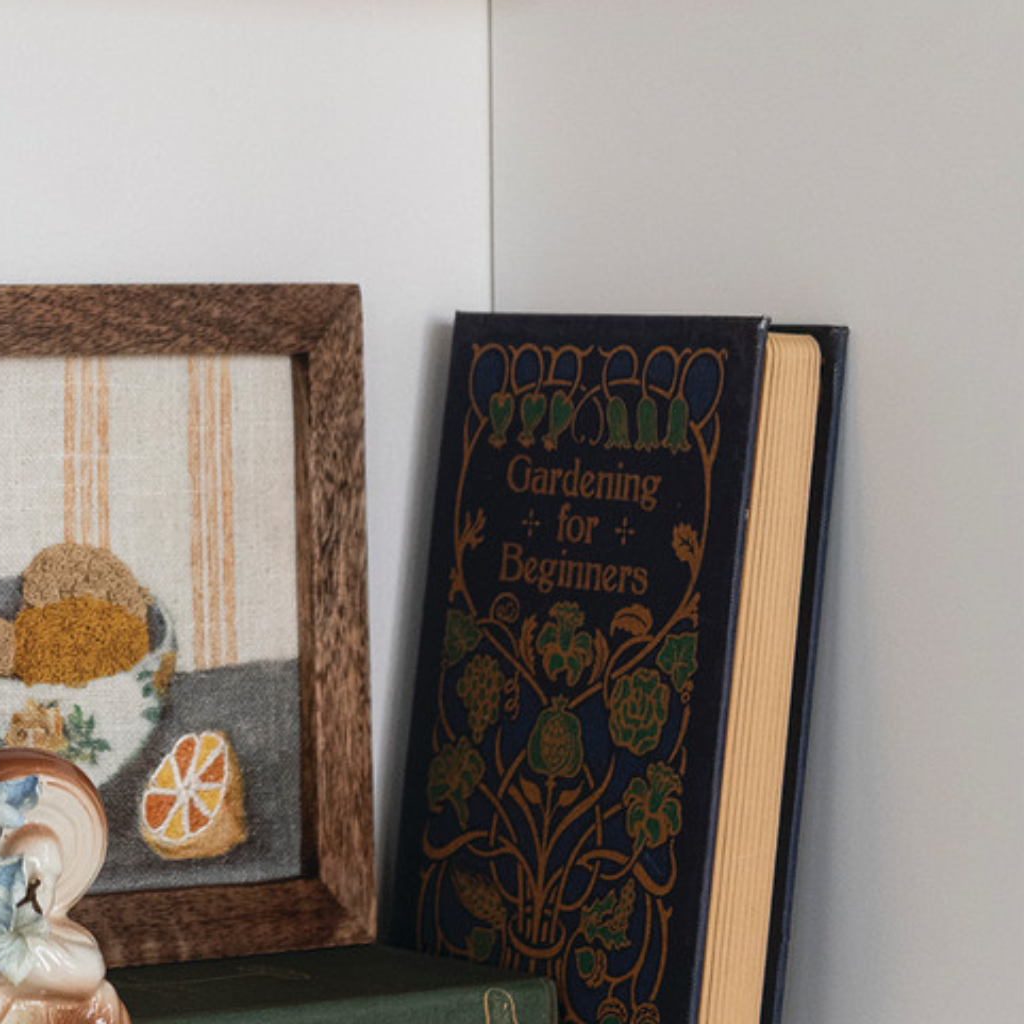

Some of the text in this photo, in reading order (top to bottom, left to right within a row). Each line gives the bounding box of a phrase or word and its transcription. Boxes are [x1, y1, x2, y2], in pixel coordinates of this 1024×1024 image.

[507, 454, 662, 511] Gardening
[557, 503, 600, 545] for
[499, 542, 650, 596] Beginners
